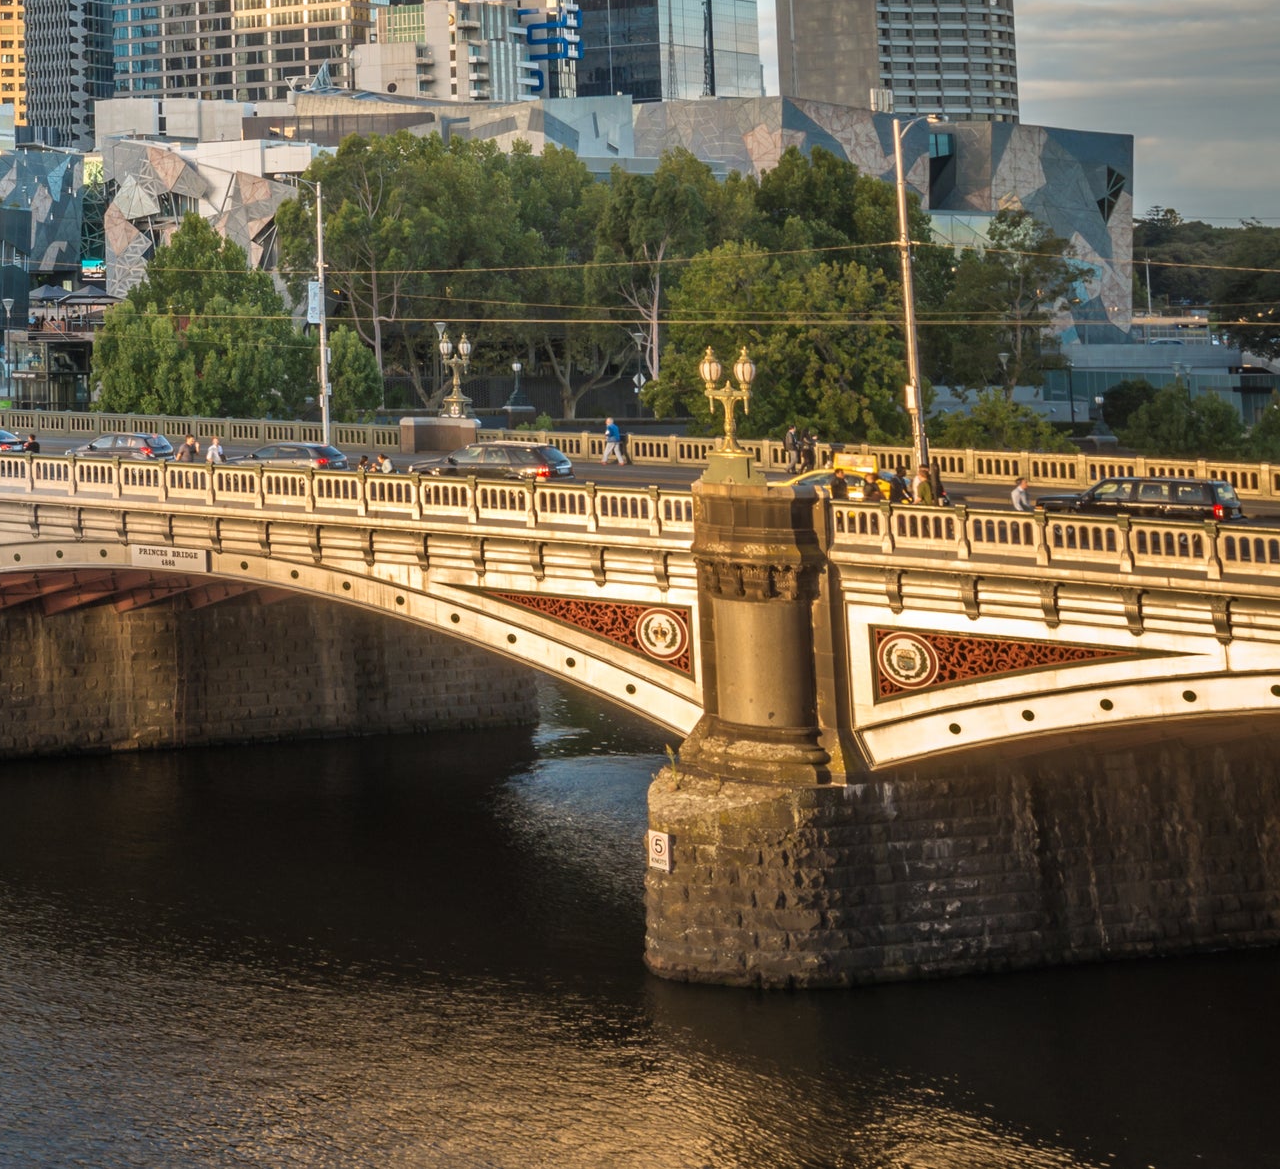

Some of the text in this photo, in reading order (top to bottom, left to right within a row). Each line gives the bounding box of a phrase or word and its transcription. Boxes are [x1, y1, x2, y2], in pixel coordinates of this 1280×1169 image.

[139, 547, 199, 560] PRINCES BRIDGE
[161, 559, 176, 567] 1888
[655, 838, 663, 854] 5
